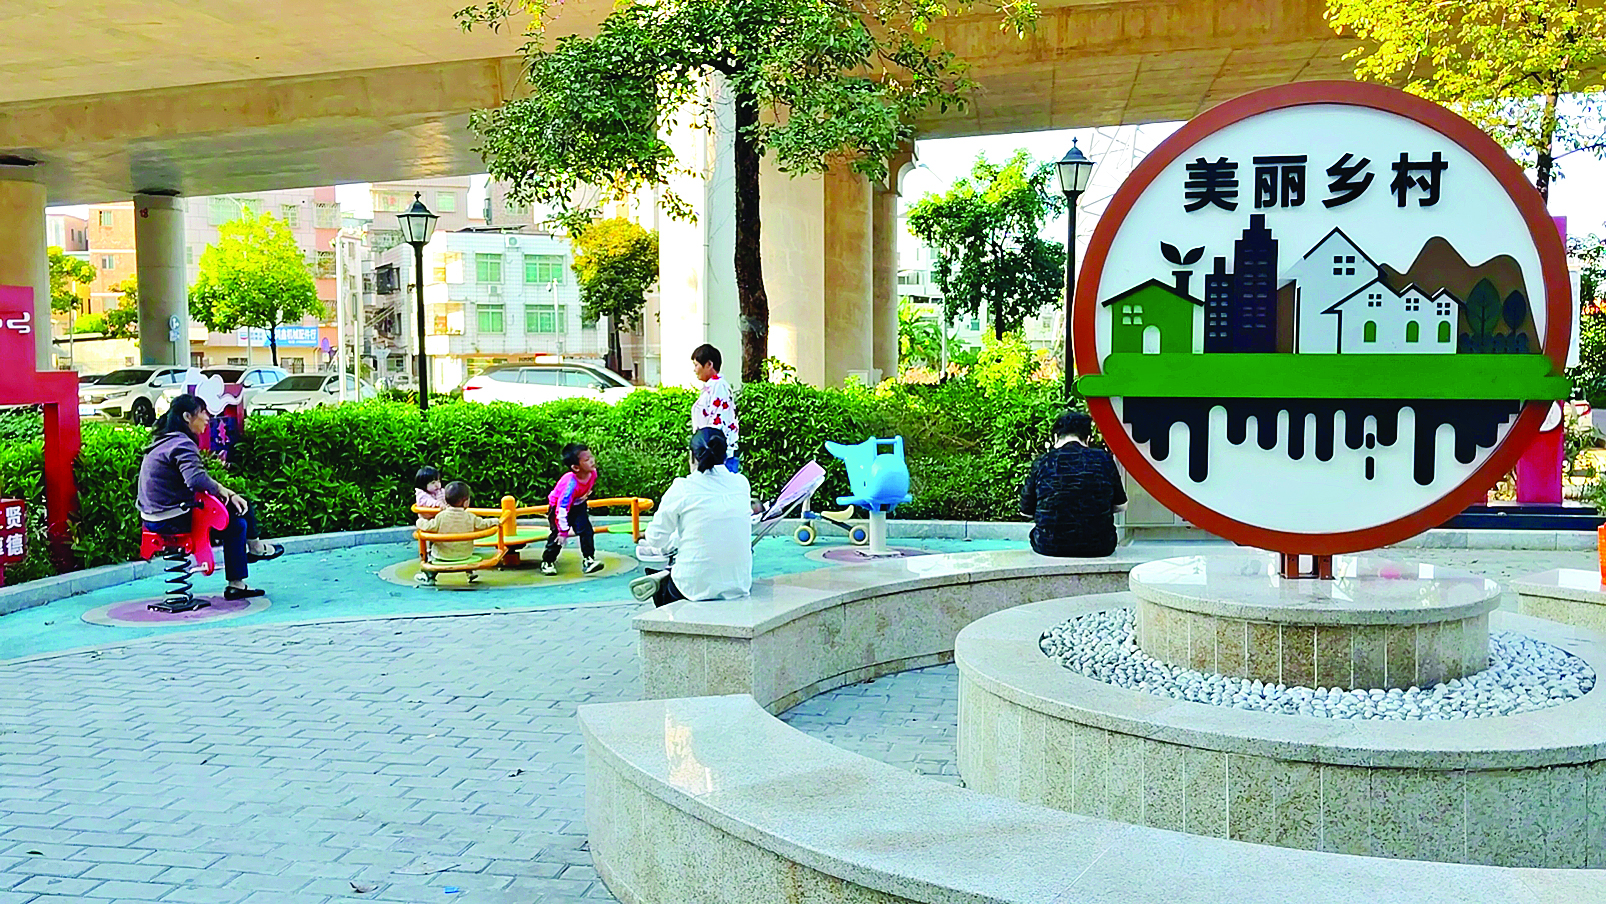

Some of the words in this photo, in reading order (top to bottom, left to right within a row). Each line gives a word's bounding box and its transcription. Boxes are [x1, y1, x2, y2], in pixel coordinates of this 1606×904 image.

[1183, 152, 1449, 213] 美丽乡村
[0, 505, 22, 530] 贤
[0, 533, 24, 556] 德
